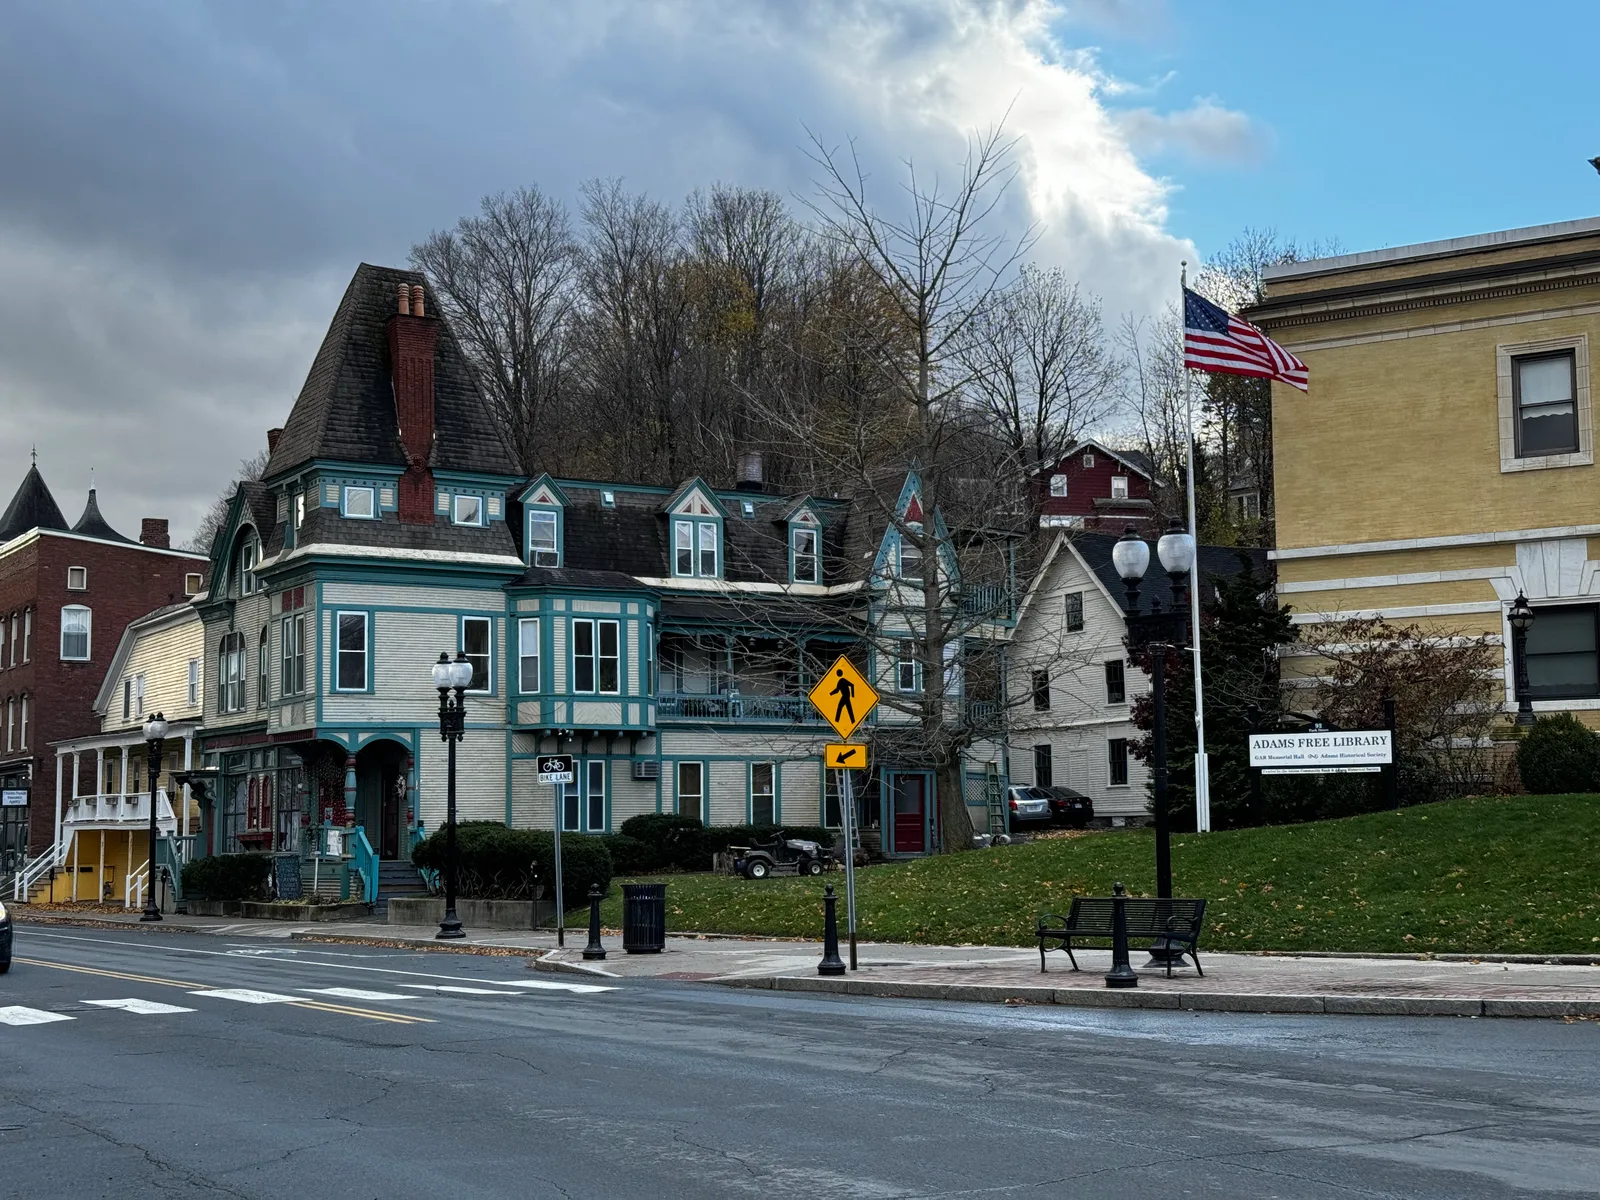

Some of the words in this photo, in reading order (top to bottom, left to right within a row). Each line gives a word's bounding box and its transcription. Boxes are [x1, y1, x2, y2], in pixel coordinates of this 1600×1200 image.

[1253, 739, 1294, 748] ADAMS
[1298, 738, 1330, 747] FREE
[1333, 736, 1388, 746] LIBRARY
